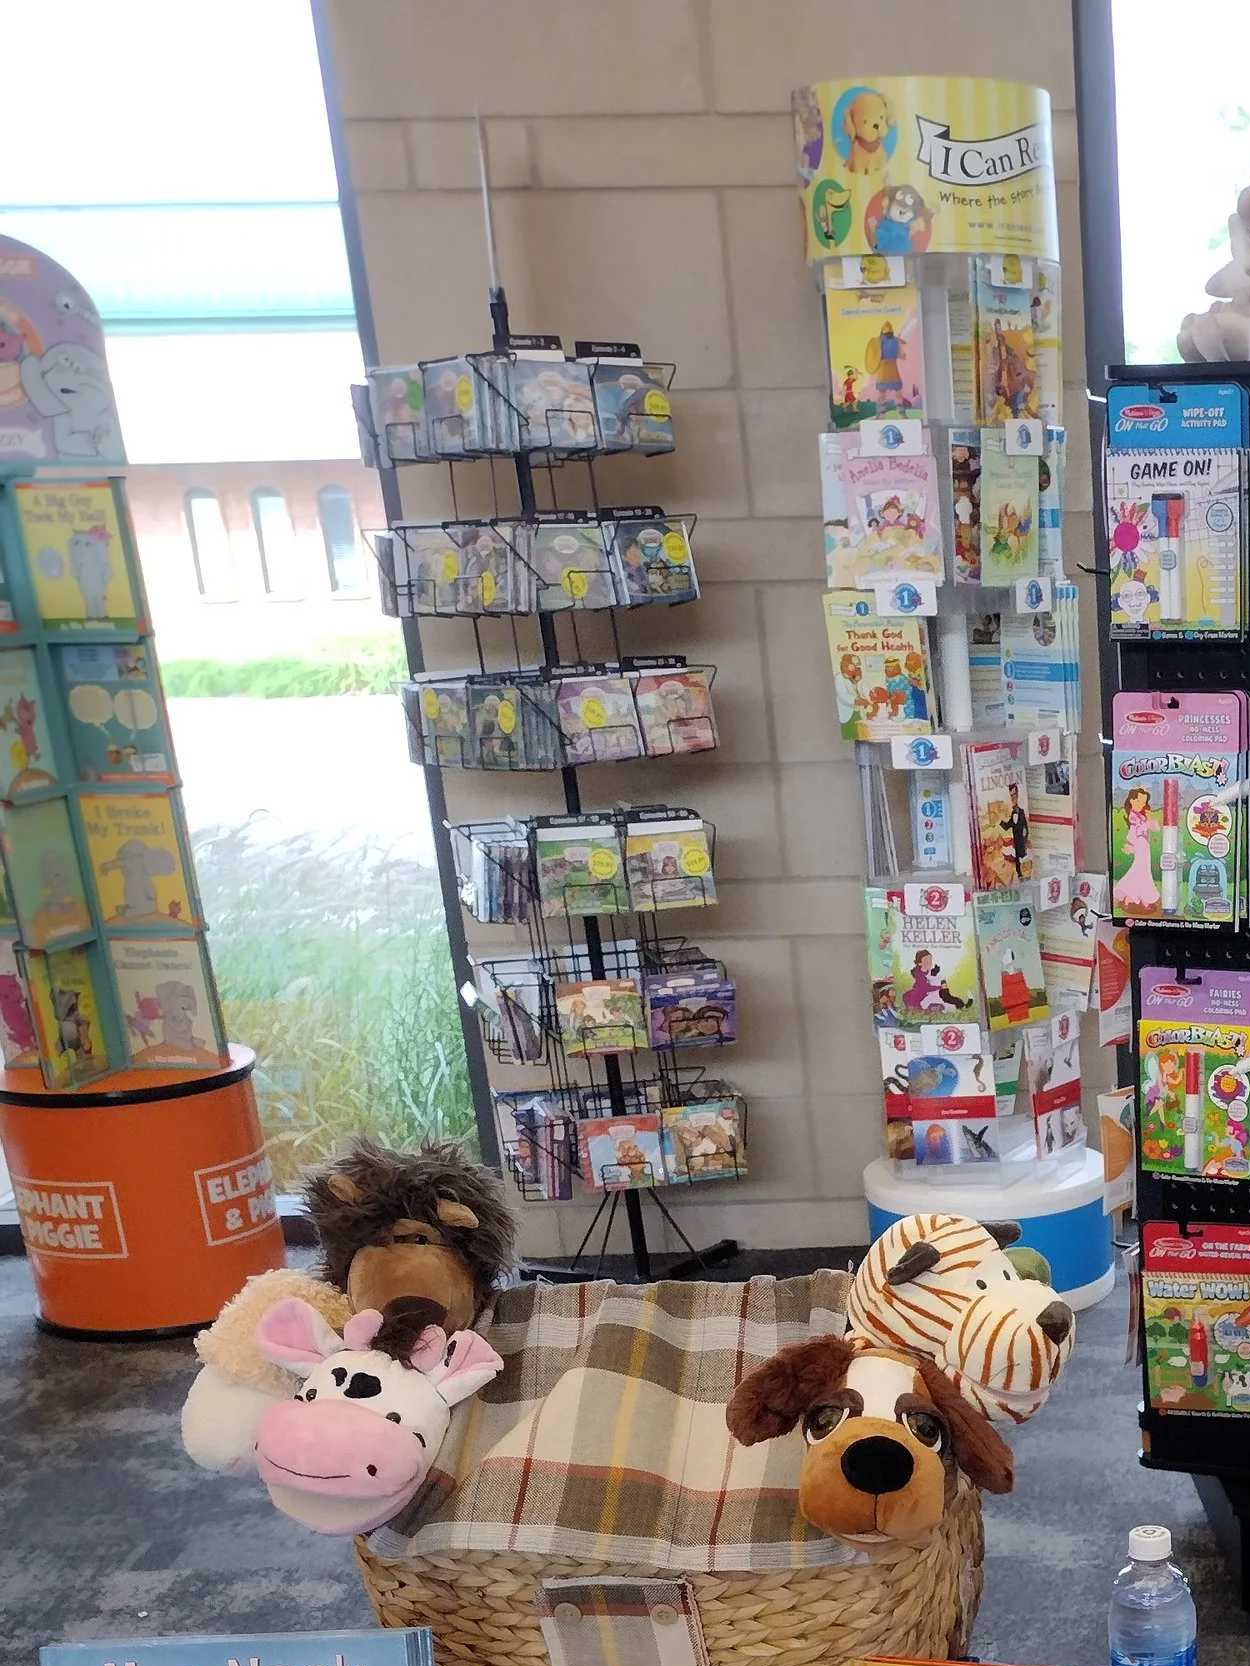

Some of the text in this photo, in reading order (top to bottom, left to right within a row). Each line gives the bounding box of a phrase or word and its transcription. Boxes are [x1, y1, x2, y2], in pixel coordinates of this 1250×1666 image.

[941, 146, 952, 176] I
[960, 149, 1014, 178] Can
[940, 191, 983, 207] Where
[988, 195, 1007, 208] the
[1011, 189, 1033, 203] story
[1182, 408, 1224, 418] WIPE-OFF
[1115, 418, 1168, 432] ON GO
[1212, 420, 1228, 428] PAD
[1130, 458, 1212, 480] GAME ON!
[845, 628, 902, 639] Thank God
[851, 642, 877, 651] Good
[1178, 714, 1231, 725] PRINCESSES
[1120, 724, 1170, 736] ON GO
[980, 770, 1024, 791] LINCOLN
[903, 916, 957, 930] HELEN
[902, 931, 962, 944] KELLER
[1209, 988, 1242, 999] FAIRIES
[1146, 995, 1194, 1007] ON GO
[225, 1208, 244, 1231] &
[1147, 1280, 1250, 1300] Water WOW!
